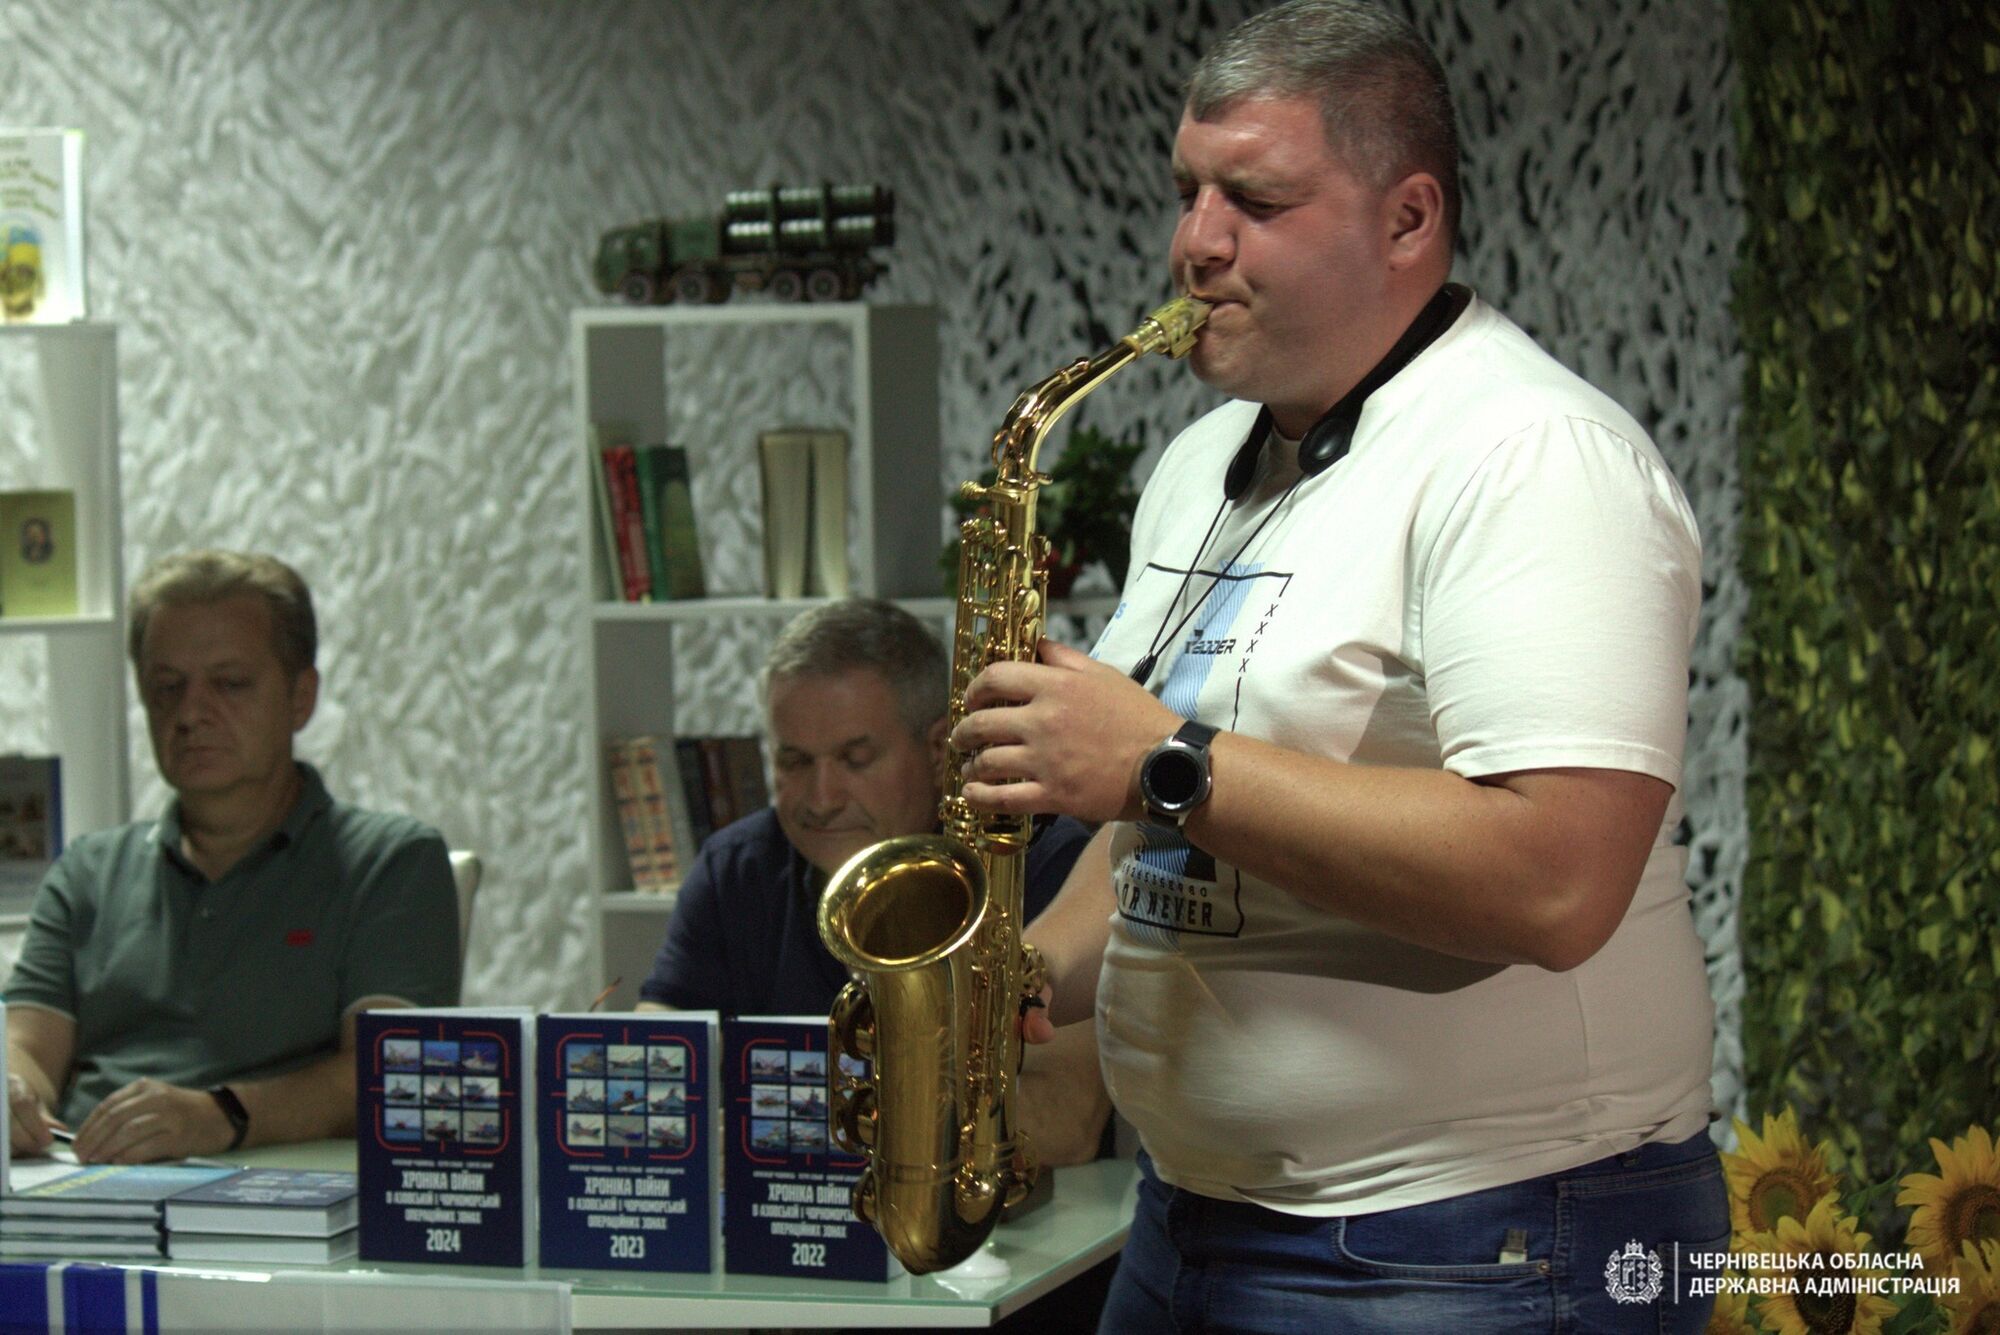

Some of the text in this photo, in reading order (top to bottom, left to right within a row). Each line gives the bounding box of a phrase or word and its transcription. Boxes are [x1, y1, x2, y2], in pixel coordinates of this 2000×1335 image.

[1121, 883, 1141, 911] OR
[1147, 890, 1213, 928] NEVER
[401, 1169, 485, 1191] ХРОНІКА ВІЙНИ
[585, 1175, 670, 1196] ХРОНІКА ВІЙНИ
[768, 1182, 850, 1205] ХРОНІКА ВІЙНИ
[426, 1228, 461, 1252] 2024
[610, 1235, 645, 1259] 2023
[792, 1242, 826, 1267] 2022
